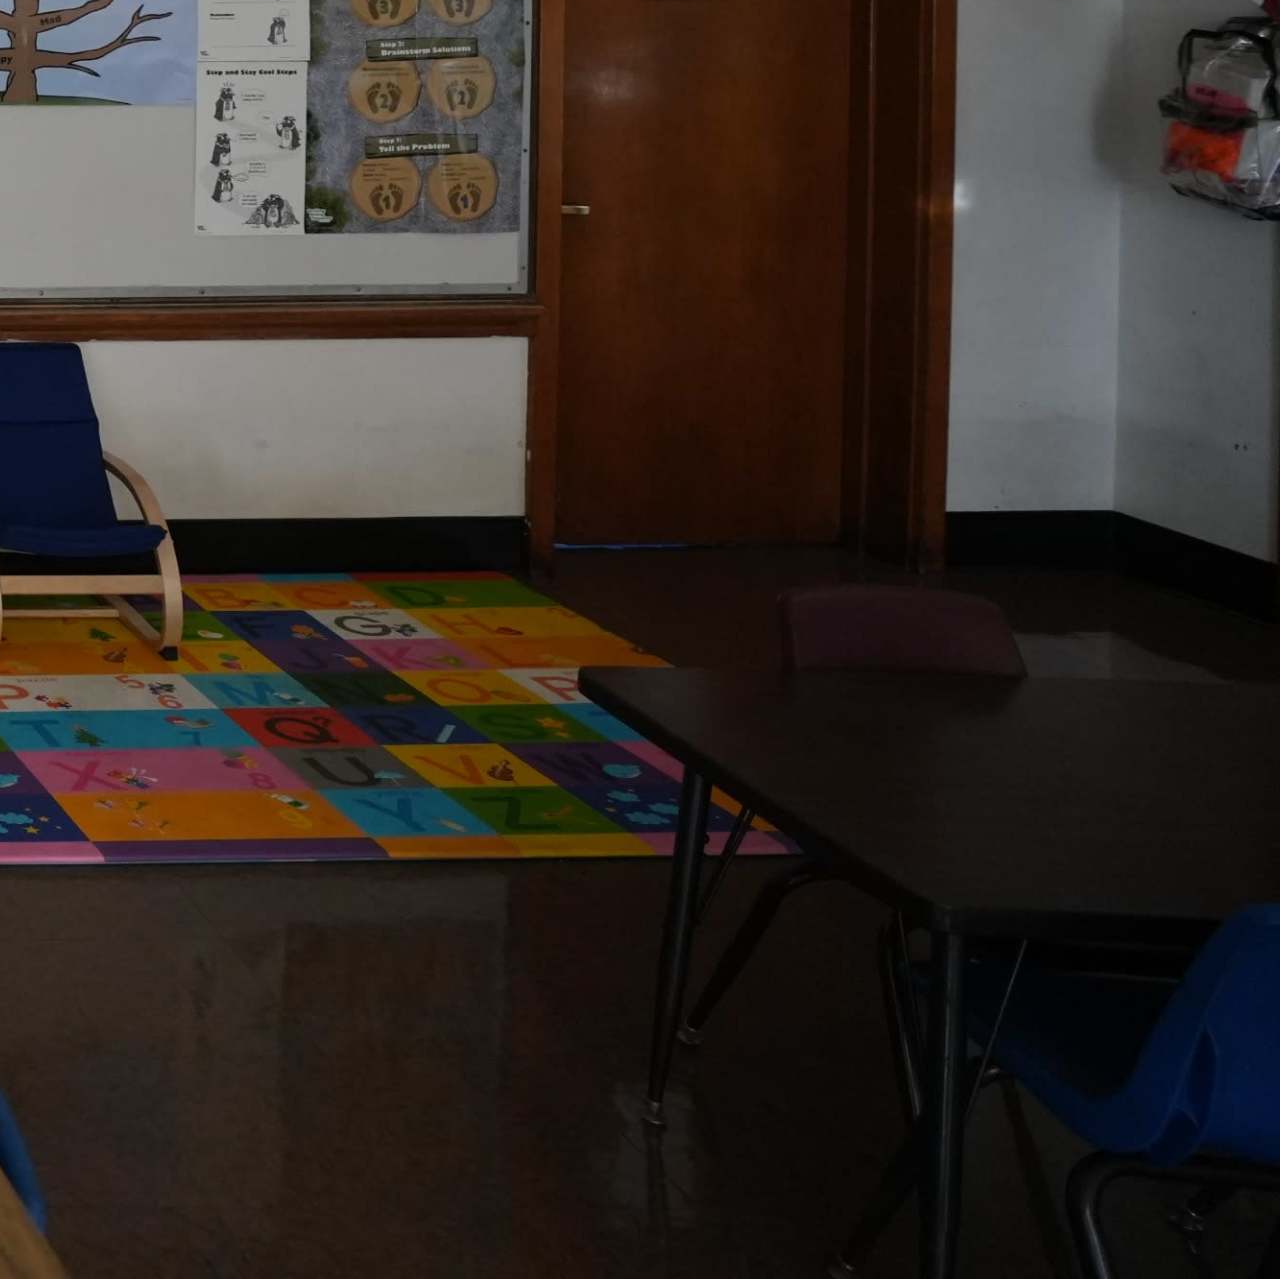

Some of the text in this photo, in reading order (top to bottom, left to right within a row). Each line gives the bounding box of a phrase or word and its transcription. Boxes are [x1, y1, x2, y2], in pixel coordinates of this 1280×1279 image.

[432, 46, 471, 54] Solutions
[379, 93, 389, 109] 2
[458, 90, 466, 106] 2
[378, 145, 395, 153] Tell
[197, 589, 242, 609] B
[294, 586, 345, 607] C
[389, 586, 445, 607] D
[334, 614, 392, 638] G
[435, 614, 487, 635] H
[373, 645, 434, 668] K
[115, 673, 146, 689] 5
[425, 677, 484, 702] O
[157, 692, 182, 709] 6
[216, 681, 281, 706] M
[9, 720, 60, 747] T
[264, 714, 336, 744] Q
[364, 715, 434, 742] R
[486, 713, 545, 739] S
[50, 761, 123, 790] X
[248, 772, 273, 788] 8
[303, 756, 376, 785] U
[423, 754, 488, 784] V
[355, 798, 423, 832] Y
[471, 794, 559, 831] Z
